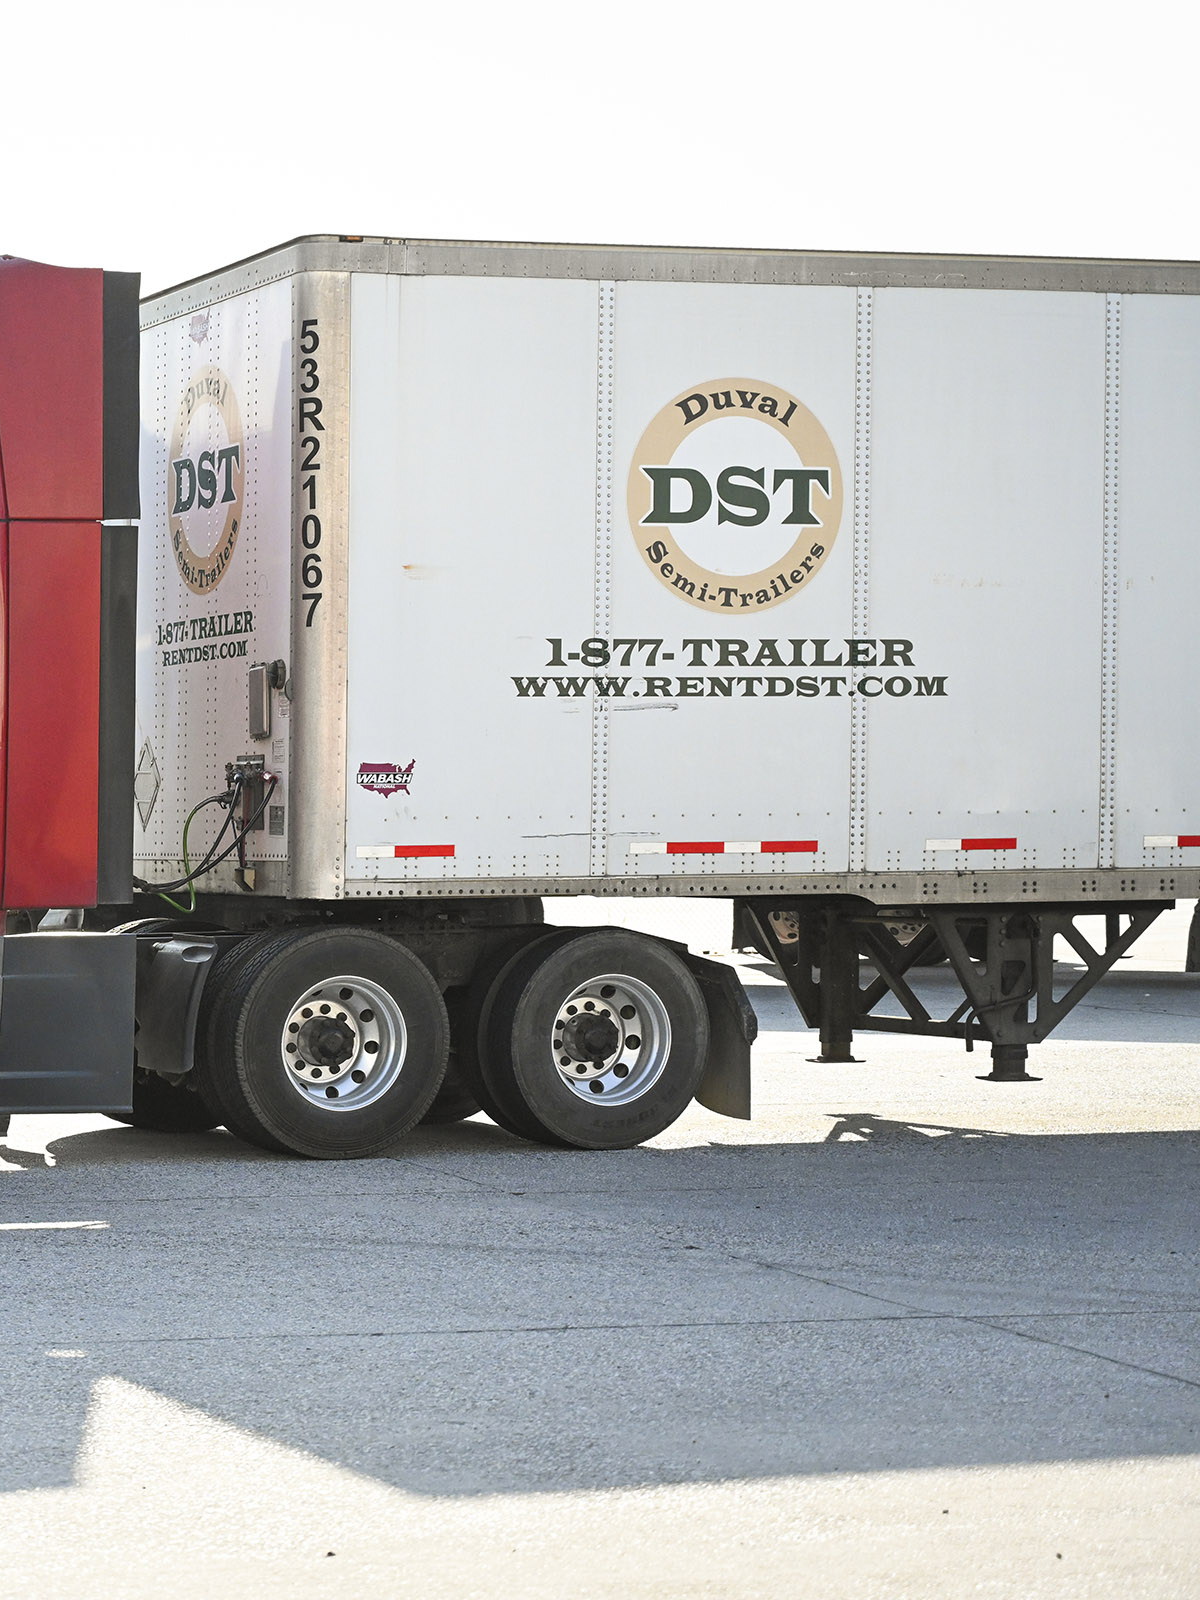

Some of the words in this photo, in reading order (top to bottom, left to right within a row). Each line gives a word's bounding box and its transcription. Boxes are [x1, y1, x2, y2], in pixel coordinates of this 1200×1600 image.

[675, 390, 798, 428] Duval
[172, 445, 241, 515] DST
[300, 319, 325, 628] 53R21067
[641, 465, 831, 527] DST
[173, 518, 238, 588] Semi-Trailers
[645, 540, 825, 608] Semi-Trailers
[157, 611, 253, 646] 1-877-TRAILER
[162, 639, 248, 667] RENTDST.COM
[545, 638, 916, 667] 1-877-TRAILER
[512, 676, 949, 698] WWW.RENTDST.COM
[357, 773, 412, 784] WABASH
